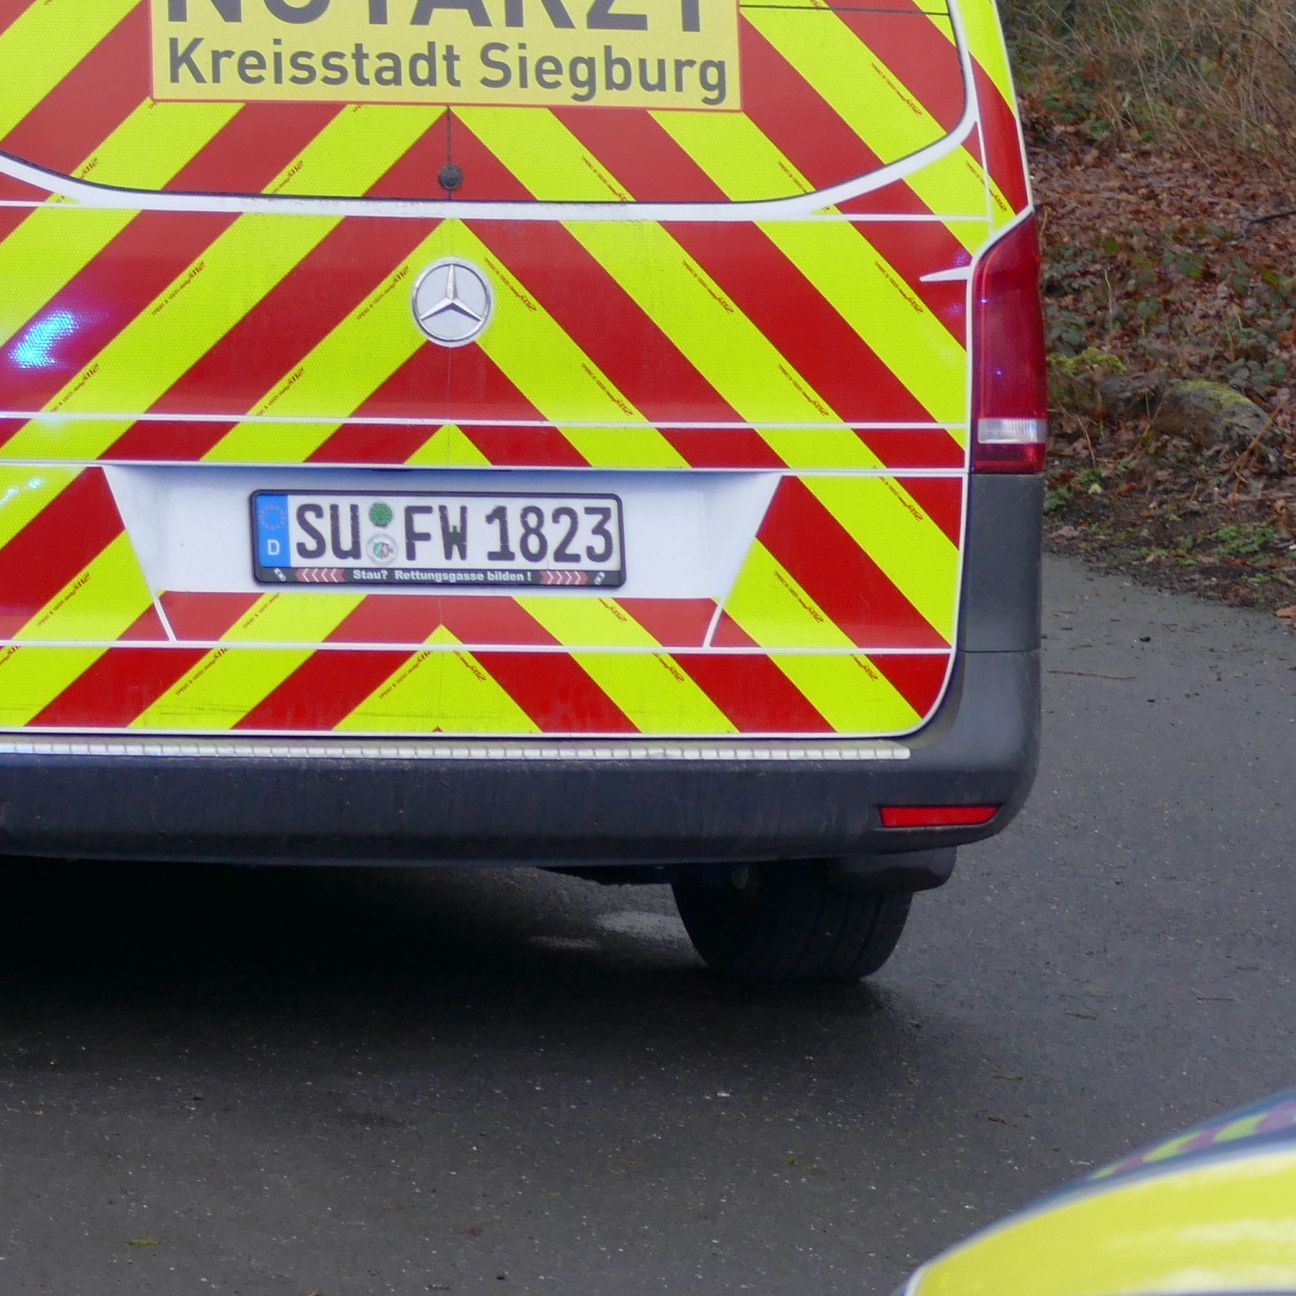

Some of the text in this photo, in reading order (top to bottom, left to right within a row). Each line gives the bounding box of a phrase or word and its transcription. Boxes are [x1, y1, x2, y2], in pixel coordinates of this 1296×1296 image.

[168, 37, 727, 107] Kreisstadt Siegburg
[265, 538, 281, 556] D
[295, 502, 614, 564] SU FW 1823
[352, 569, 389, 581] Stau?
[394, 570, 485, 584] Rettungsgasse
